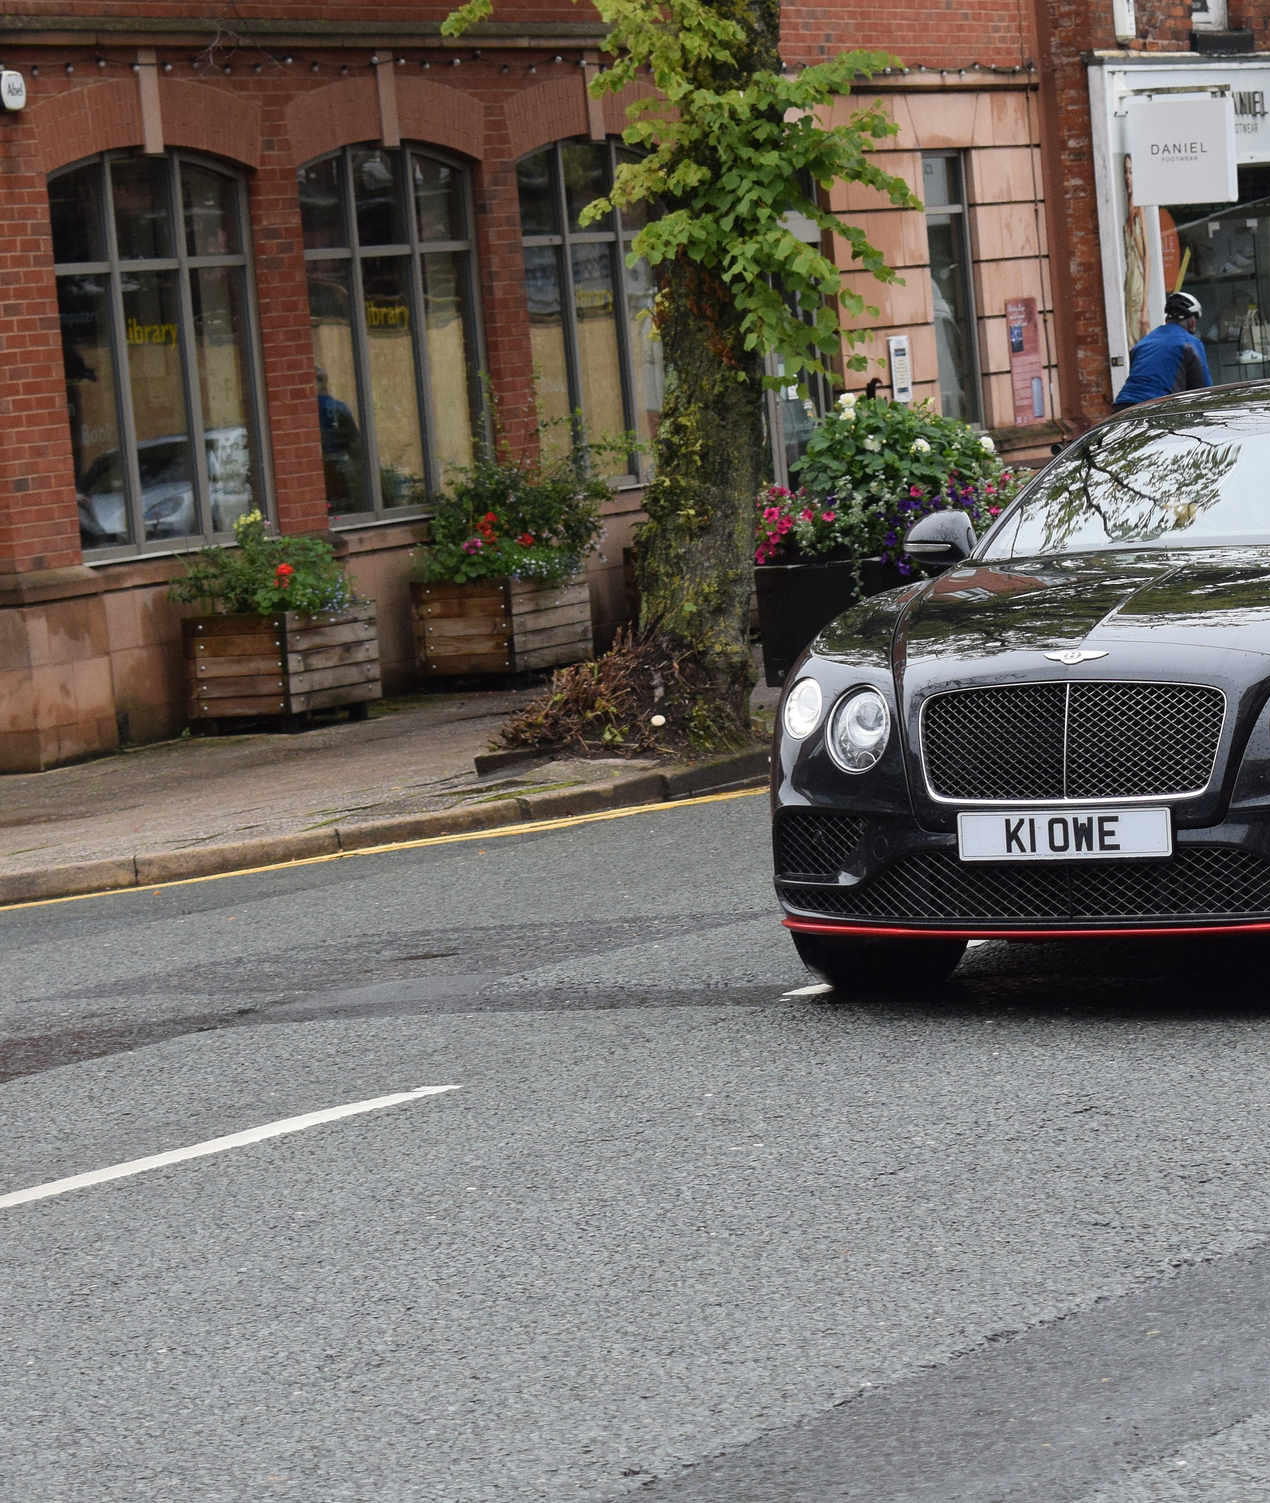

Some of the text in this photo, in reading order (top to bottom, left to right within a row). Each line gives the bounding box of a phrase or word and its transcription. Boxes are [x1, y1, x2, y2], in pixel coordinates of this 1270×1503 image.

[1234, 122, 1260, 134] OTWEAR
[1150, 142, 1208, 155] DANIEL
[364, 301, 410, 330] ibrary
[1048, 816, 1121, 853] OWE
